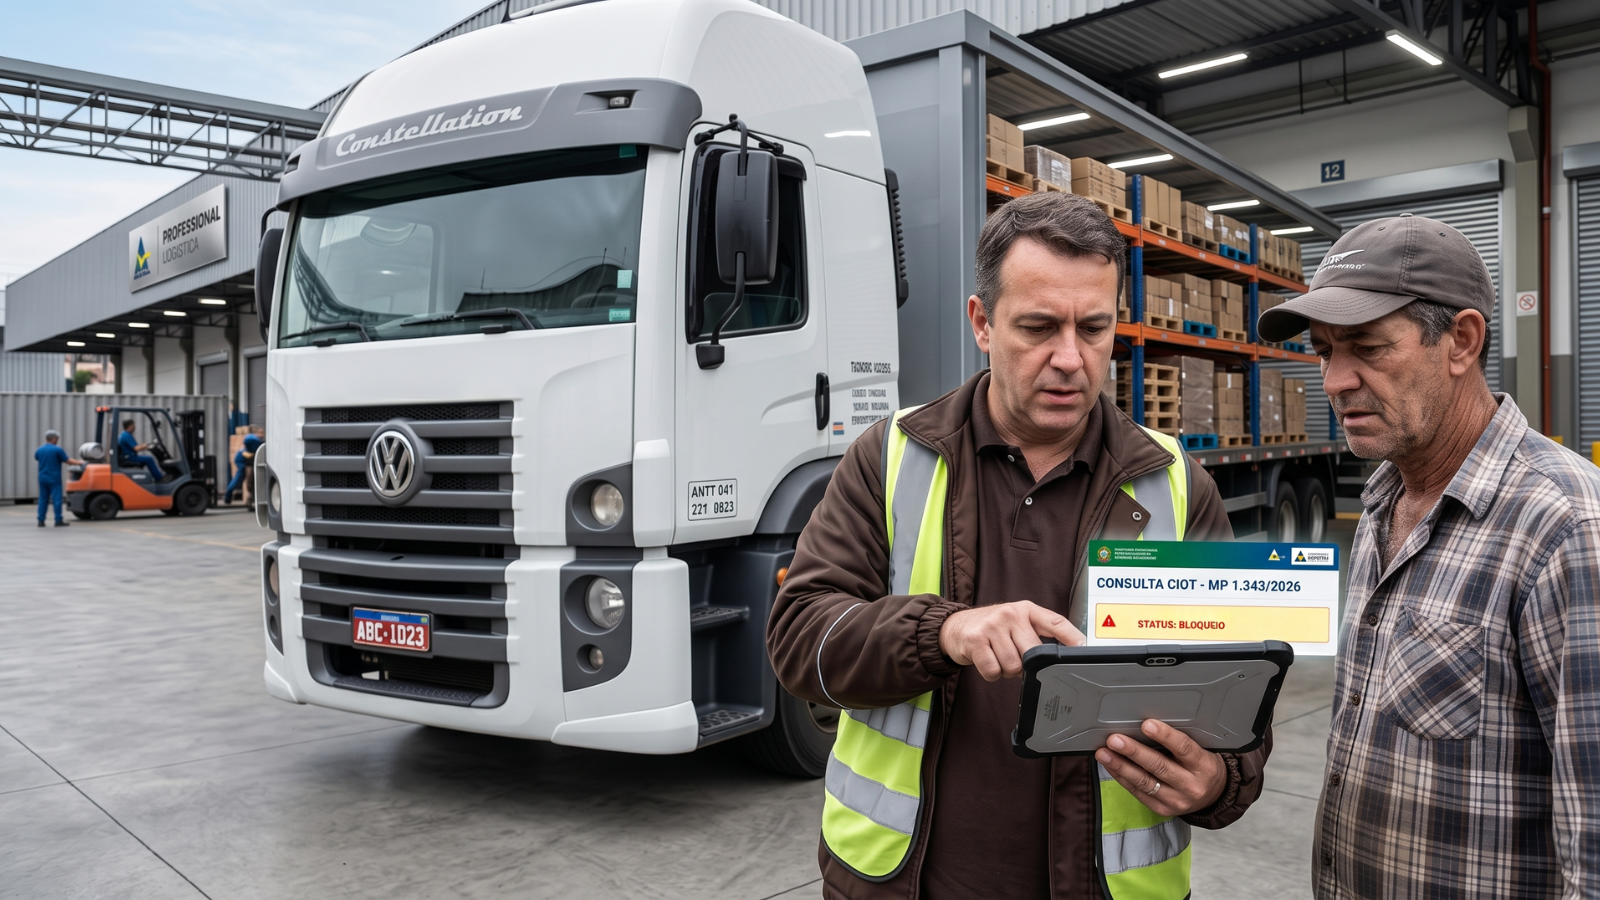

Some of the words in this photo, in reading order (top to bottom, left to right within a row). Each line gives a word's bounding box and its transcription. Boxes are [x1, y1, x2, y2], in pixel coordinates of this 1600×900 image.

[336, 104, 523, 156] Constellation
[1325, 164, 1340, 179] 12
[162, 205, 221, 245] PROFESSIONAL
[691, 485, 716, 498] ANTT
[718, 484, 733, 496] 041
[691, 503, 707, 515] 221
[1096, 577, 1164, 590] CONSULTA
[1167, 578, 1197, 590] CIOT
[1208, 579, 1229, 591] MP
[1232, 580, 1301, 592] 1.343/2026
[1137, 620, 1177, 629] STATUS:
[1178, 620, 1226, 631] BLOQUEIO
